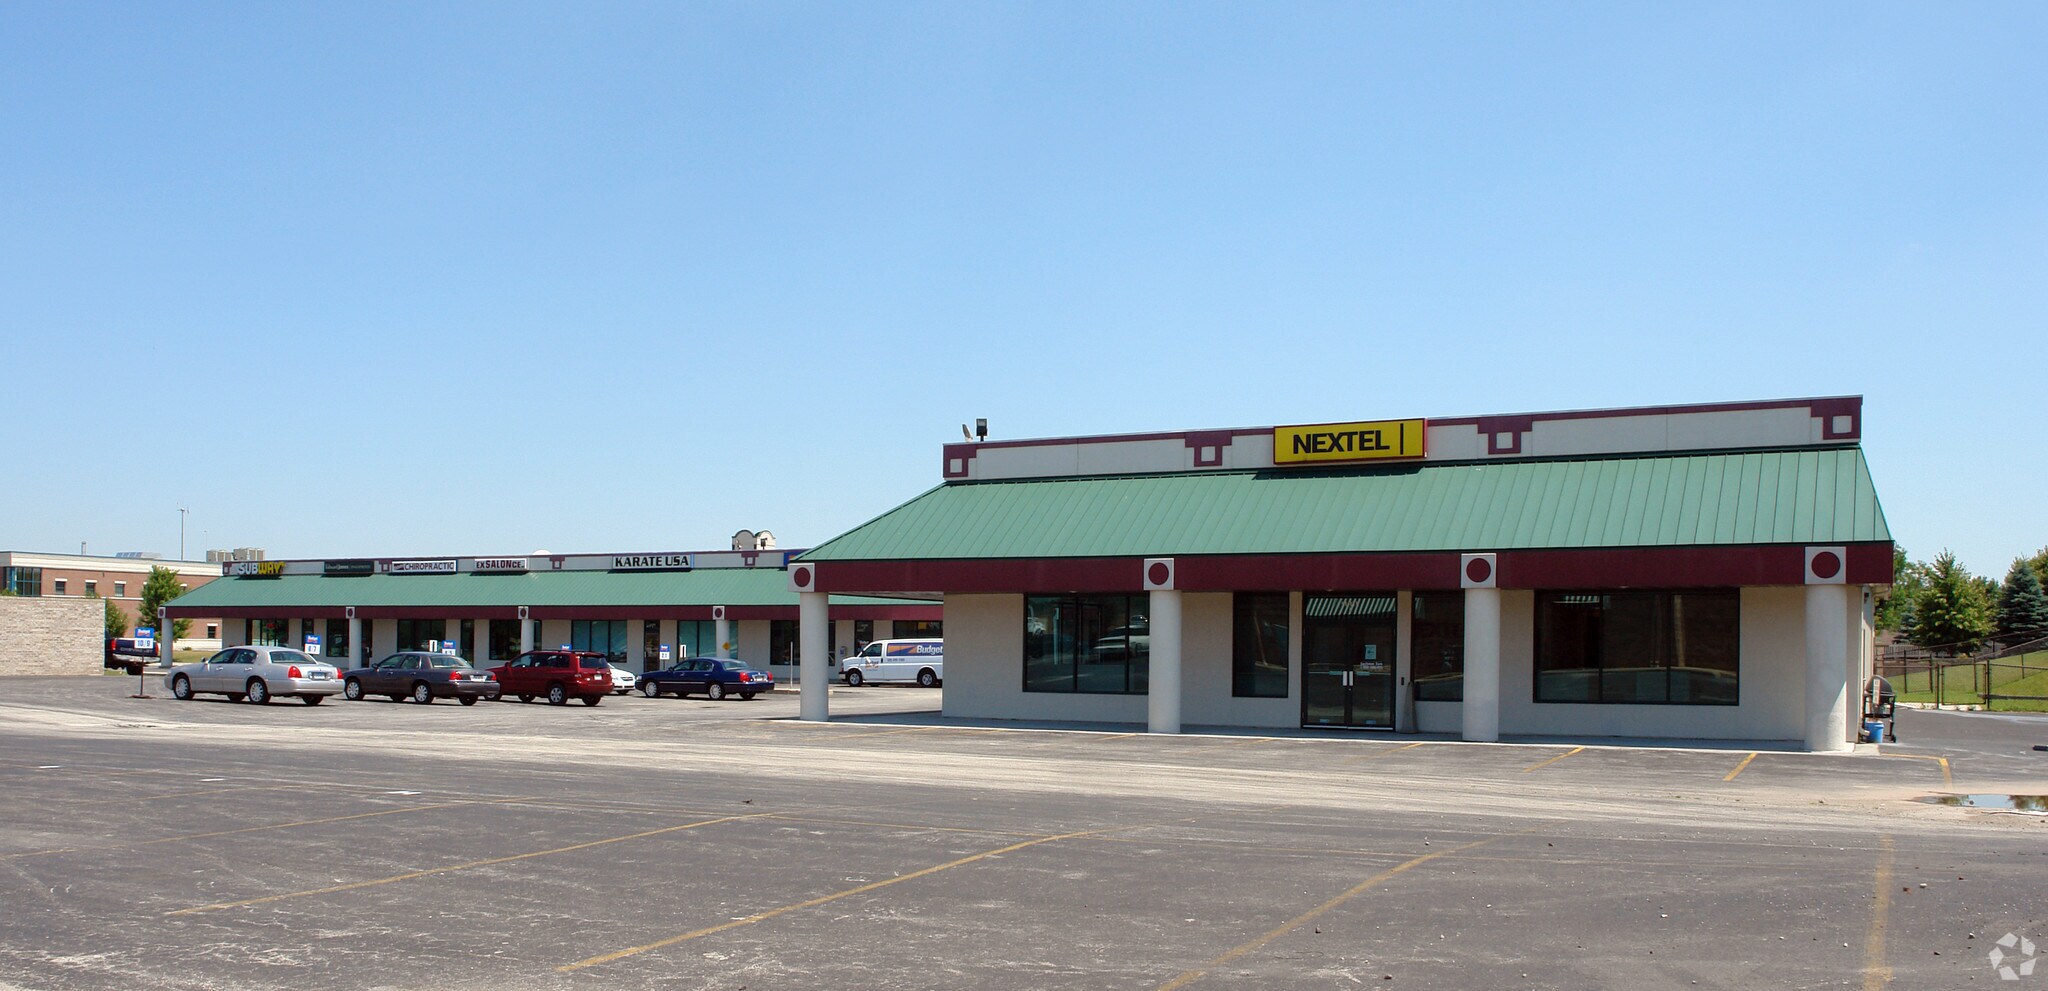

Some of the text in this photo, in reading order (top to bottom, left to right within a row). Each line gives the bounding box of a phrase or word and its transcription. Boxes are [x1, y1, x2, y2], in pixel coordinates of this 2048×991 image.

[1293, 430, 1390, 454] NEXTEL
[404, 562, 454, 571] CHIROPRACTIC
[615, 555, 689, 567] KARATE USA
[237, 561, 283, 575] SUBWAY
[916, 645, 943, 655] Budget
